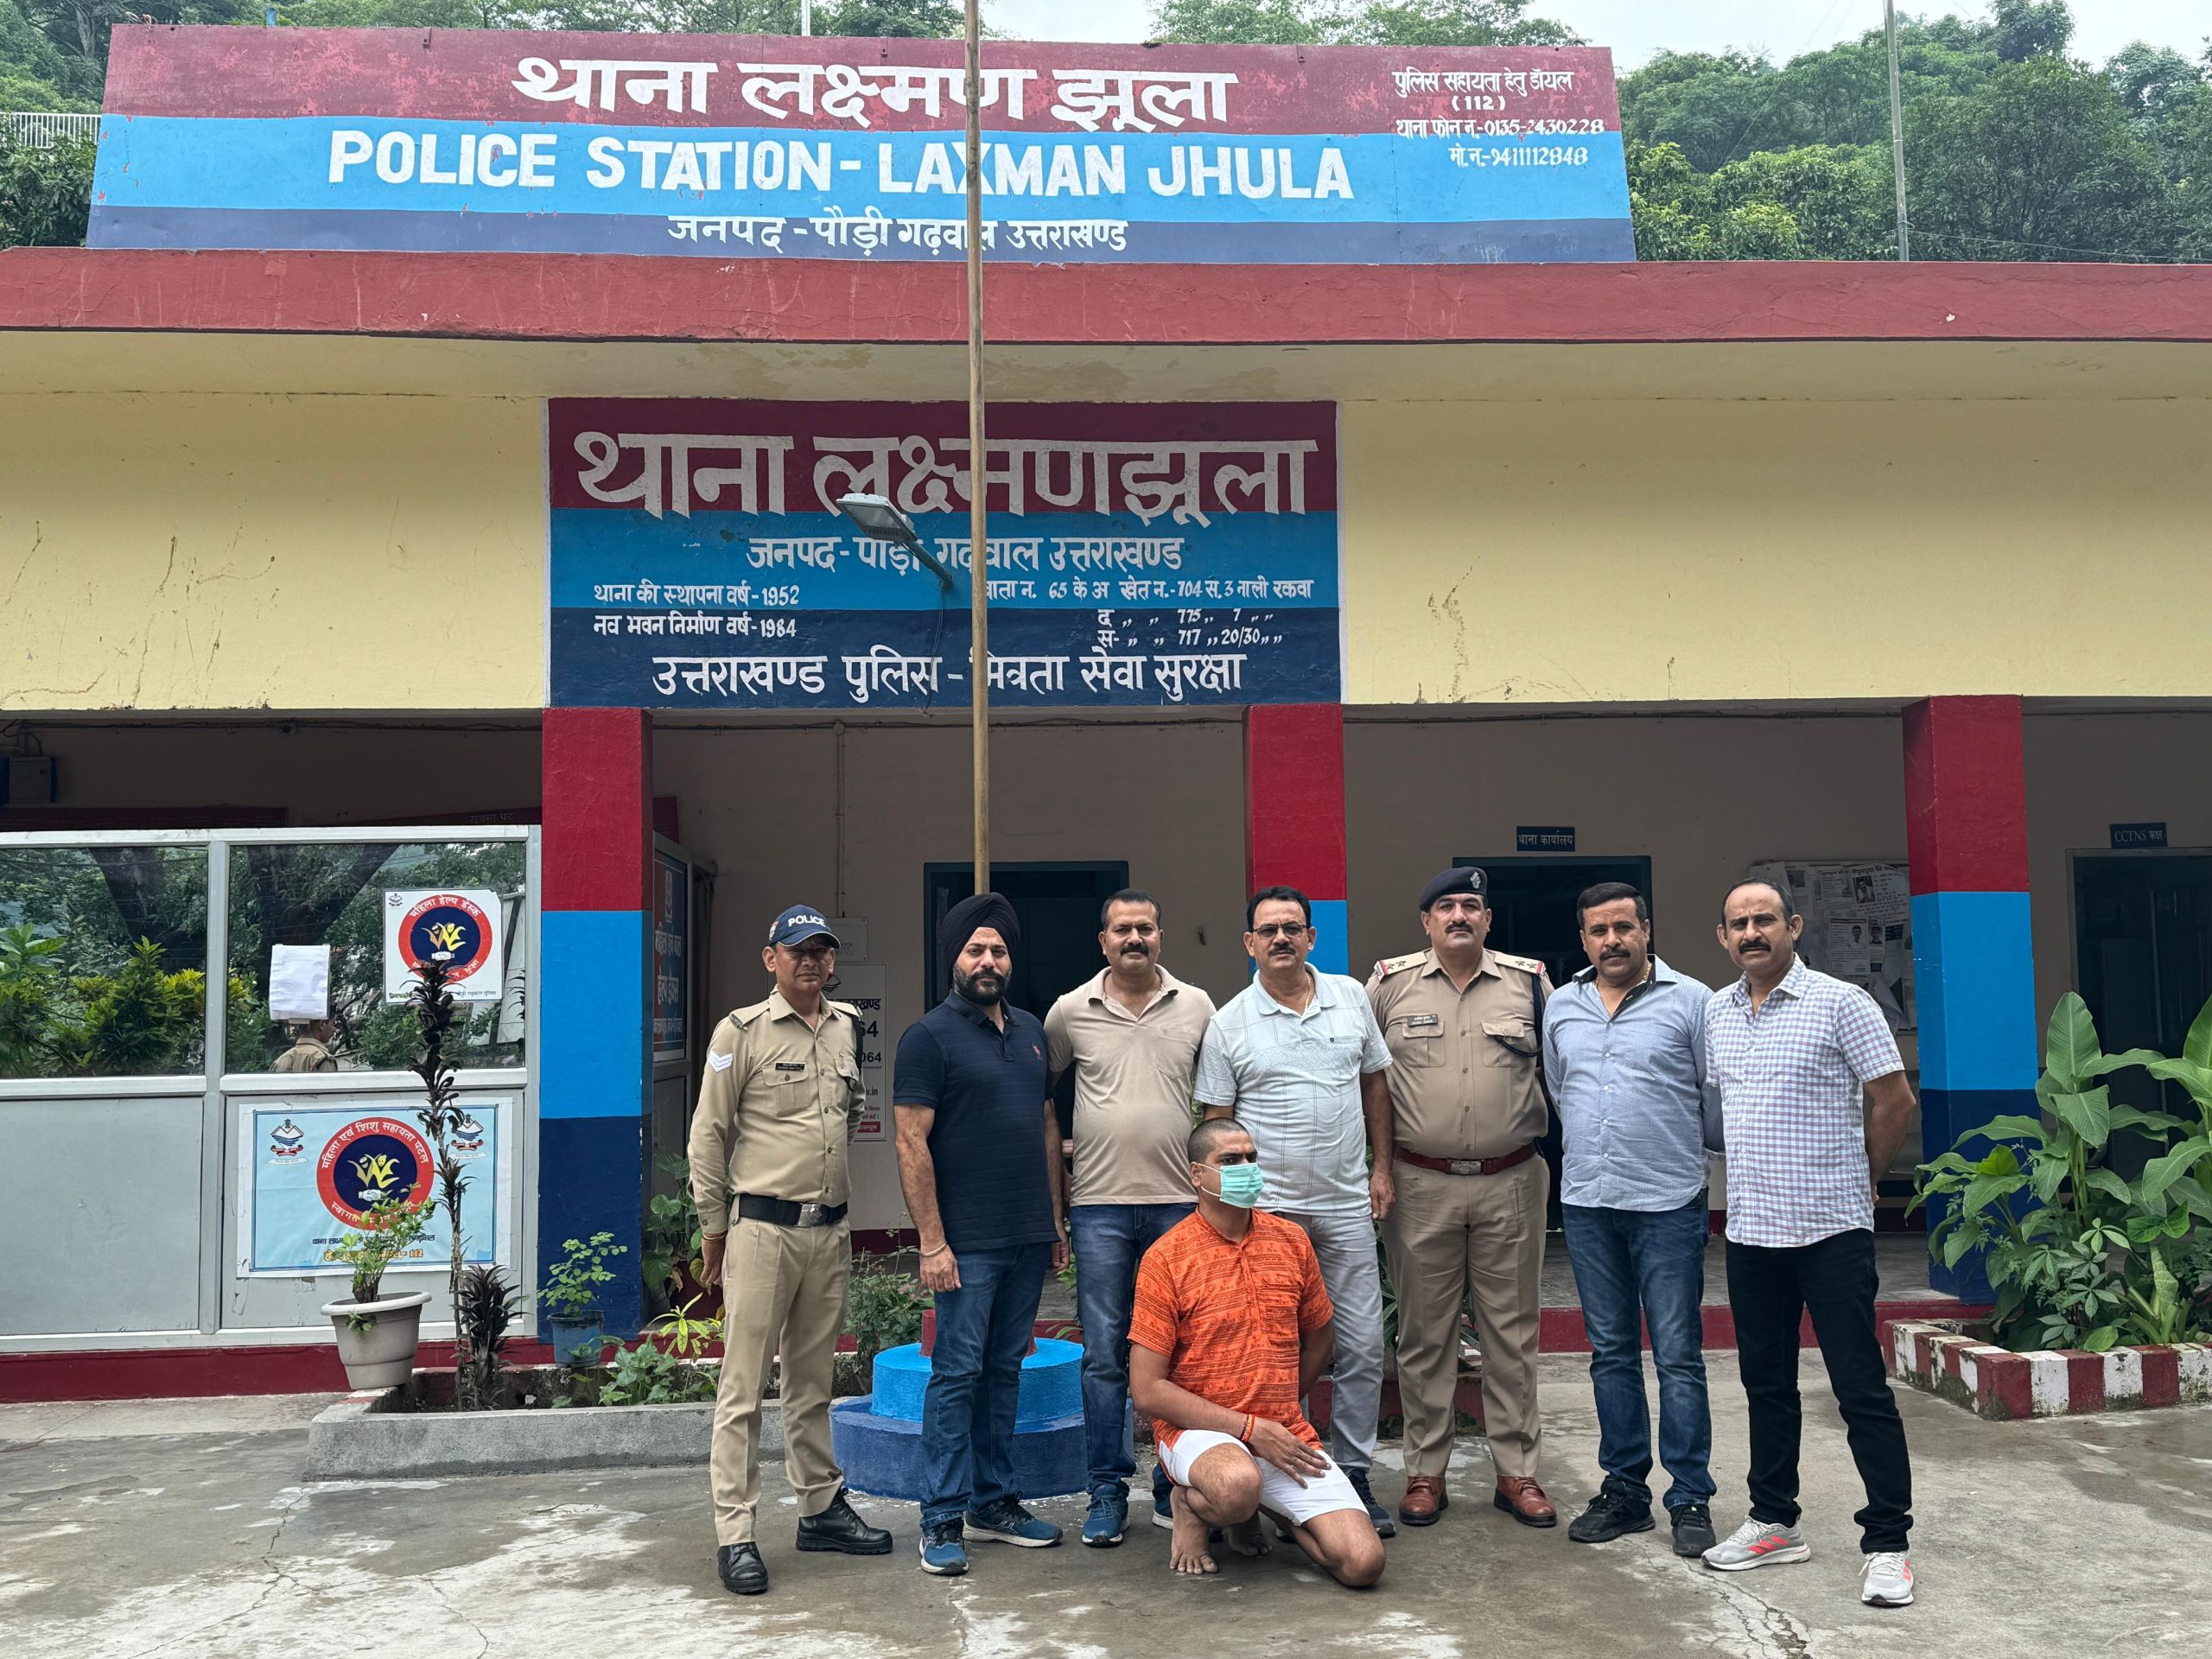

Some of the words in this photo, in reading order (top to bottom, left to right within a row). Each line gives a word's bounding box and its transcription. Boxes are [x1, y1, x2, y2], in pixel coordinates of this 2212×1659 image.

[512, 56, 719, 114] थाना
[736, 63, 1038, 128] लक्ष्मण
[1050, 68, 1239, 133] झूला
[1391, 66, 1440, 98] पुलिस
[1441, 72, 1502, 93] सहायता
[1503, 67, 1527, 97] हेतु
[1395, 118, 1429, 140] थाना
[1430, 115, 1461, 139] फोन
[328, 130, 557, 188] POLICE
[879, 142, 1125, 196] LAXMAN
[1147, 146, 1355, 200] JHULA
[1006, 219, 1128, 251] उत्तराखण्ड
[573, 431, 795, 520] थाना
[1049, 537, 1185, 572] उत्तराखण्ड
[594, 584, 636, 602] थाना
[636, 578, 661, 604] की
[664, 584, 724, 607] स्थापना
[1048, 582, 1067, 599] 65
[1072, 575, 1088, 600] के
[1091, 582, 1110, 599] अ
[1119, 575, 1151, 601] खेत
[1224, 582, 1234, 598] 3
[1236, 575, 1269, 600] नाली
[594, 614, 622, 636] नव
[626, 615, 666, 636] भवन
[668, 610, 723, 636] निर्माण
[1177, 608, 1202, 624] 775
[1233, 608, 1242, 621] 7
[1178, 629, 1201, 645] 717
[652, 655, 828, 697] उत्तराखण्ड
[841, 644, 944, 704] पुलिस
[1079, 645, 1147, 693] सेवा
[1154, 652, 1249, 702] सुरक्षा
[1540, 830, 1573, 846] कार्यालय
[2114, 830, 2147, 842] CCTNS
[788, 915, 827, 928] POLICE
